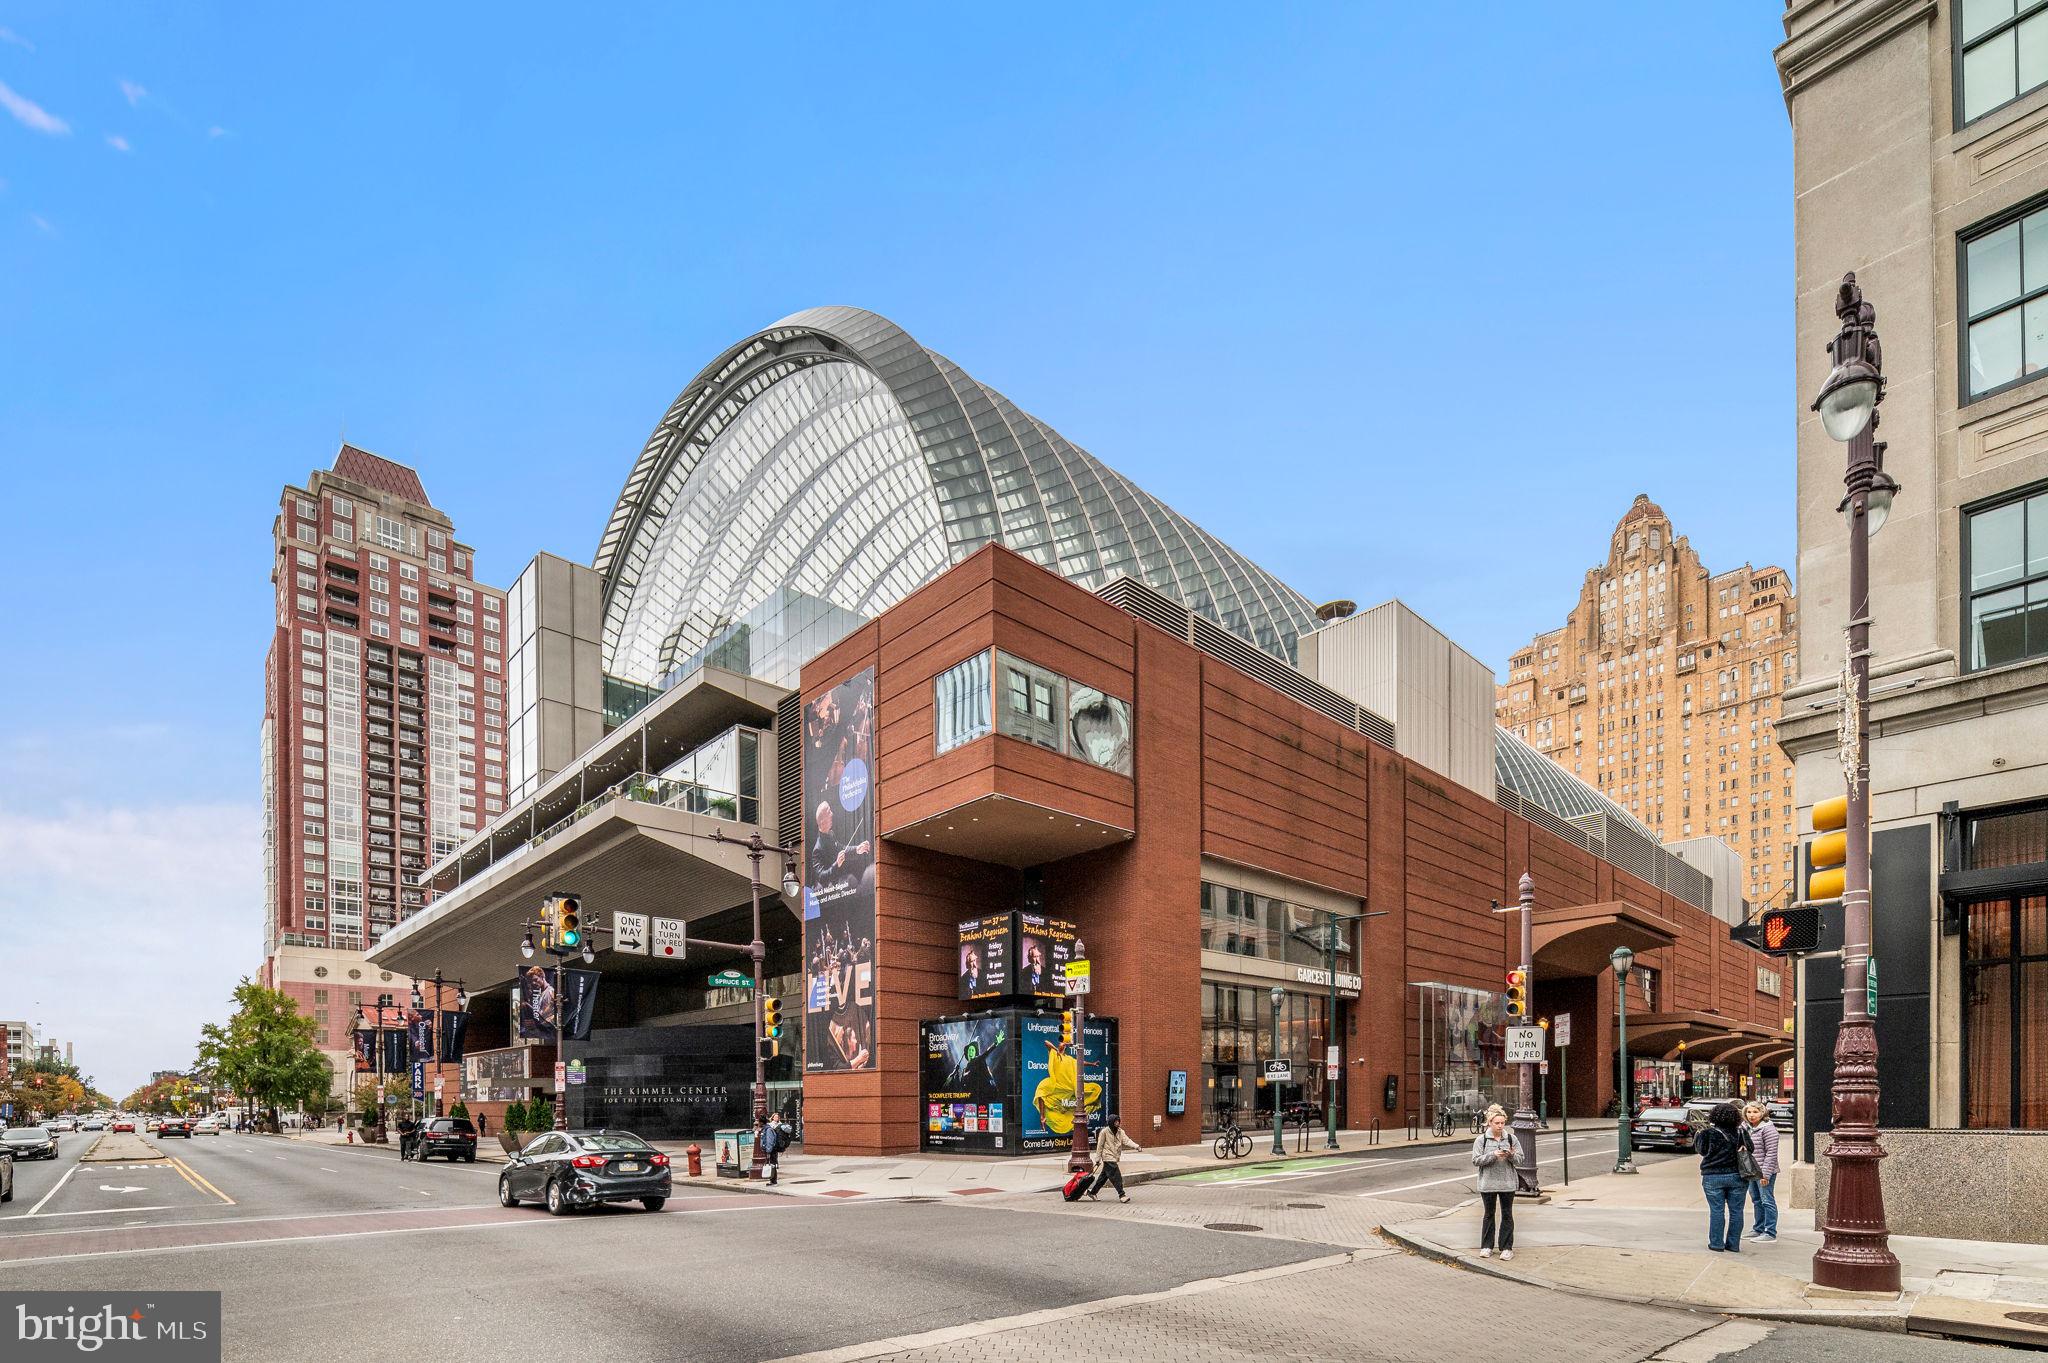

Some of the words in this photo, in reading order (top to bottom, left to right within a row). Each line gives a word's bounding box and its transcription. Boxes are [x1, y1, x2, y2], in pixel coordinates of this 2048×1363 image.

[841, 888, 857, 898] Director
[621, 917, 641, 927] ONE
[660, 921, 678, 931] NO
[620, 927, 642, 938] WAY
[658, 931, 681, 939] TURN
[669, 939, 683, 947] RED
[989, 942, 1003, 950] Friday
[1054, 945, 1068, 953] Friday
[994, 962, 1002, 970] pm
[715, 978, 740, 986] SPRUCE
[1297, 968, 1324, 985] GARCES
[1352, 976, 1362, 990] CO
[808, 961, 872, 1013] LIVE
[532, 989, 541, 1021] Theater
[929, 1032, 959, 1042] Broadway
[1519, 1031, 1534, 1039] NO
[929, 1042, 949, 1051] Series
[1070, 1047, 1092, 1055] Thter
[1524, 1050, 1541, 1058] RED
[414, 1062, 422, 1089] PARK
[1083, 1072, 1104, 1081] lassical
[603, 1087, 623, 1095] THE
[629, 1087, 673, 1095] KIMMEL
[680, 1086, 728, 1095] CENTER
[1024, 1140, 1040, 1149] Come
[1041, 1139, 1055, 1148] Early
[1055, 1138, 1067, 1147] Stay
